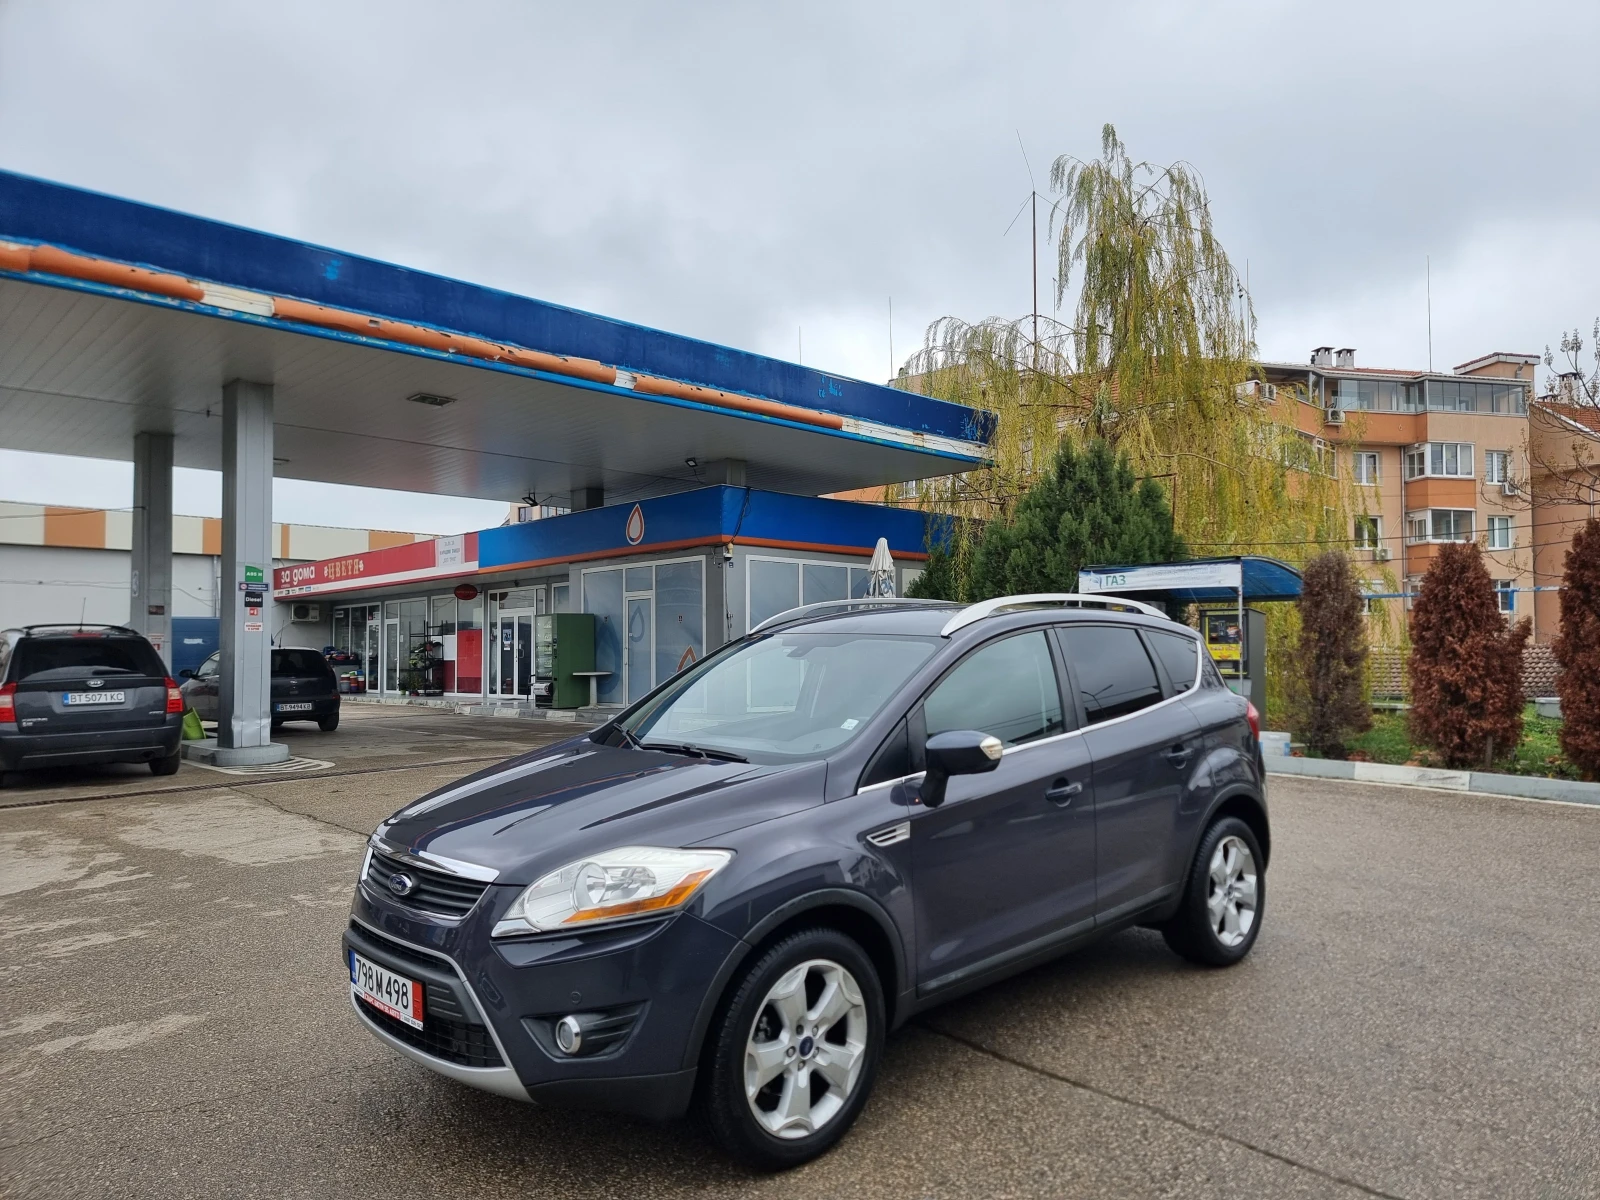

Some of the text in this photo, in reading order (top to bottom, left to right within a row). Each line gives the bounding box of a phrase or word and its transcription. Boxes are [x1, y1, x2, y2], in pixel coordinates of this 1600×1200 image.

[328, 559, 360, 579] ЦВЕТЯ
[280, 570, 291, 583] за
[1105, 574, 1126, 586] ГАЗ
[70, 692, 123, 703] BT 5071 KC
[355, 957, 374, 992] 798
[375, 969, 384, 999] M
[385, 976, 409, 1010] 498
